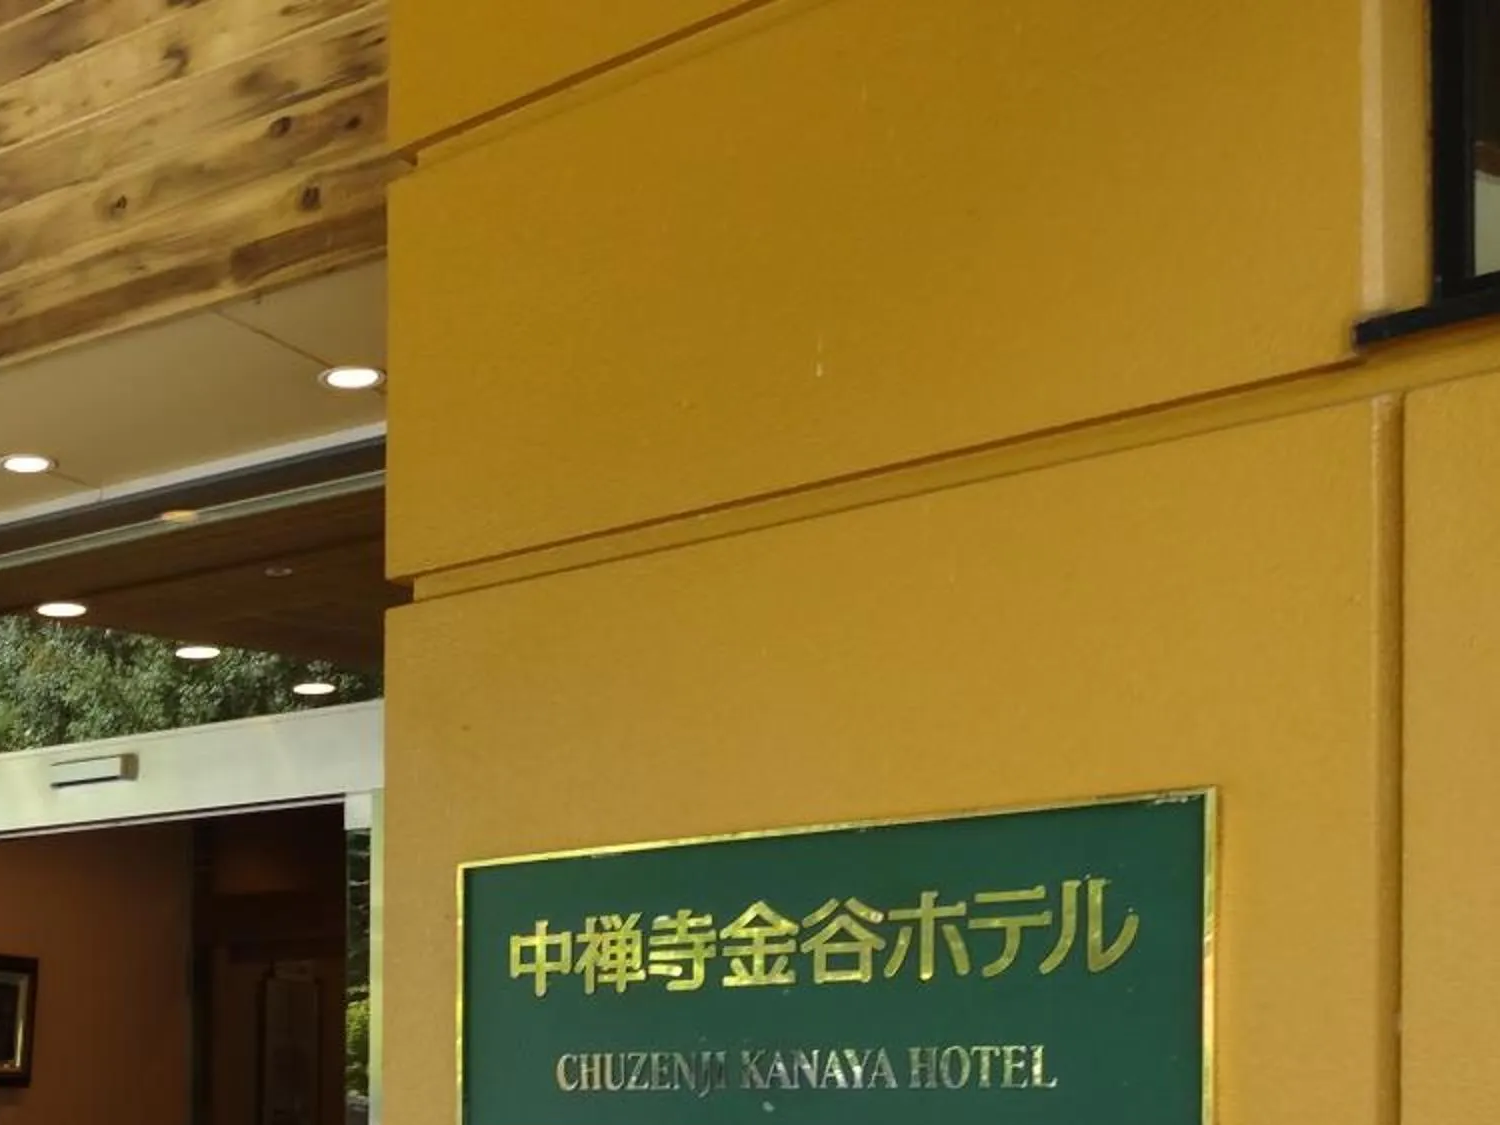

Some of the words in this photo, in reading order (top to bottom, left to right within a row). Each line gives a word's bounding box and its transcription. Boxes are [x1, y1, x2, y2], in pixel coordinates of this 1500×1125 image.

[510, 877, 1140, 997] 中禅寺金谷ホテル
[556, 1050, 727, 1098] CHUZENJI
[740, 1047, 898, 1090] KANAYA
[908, 1045, 1058, 1090] HOTEL
